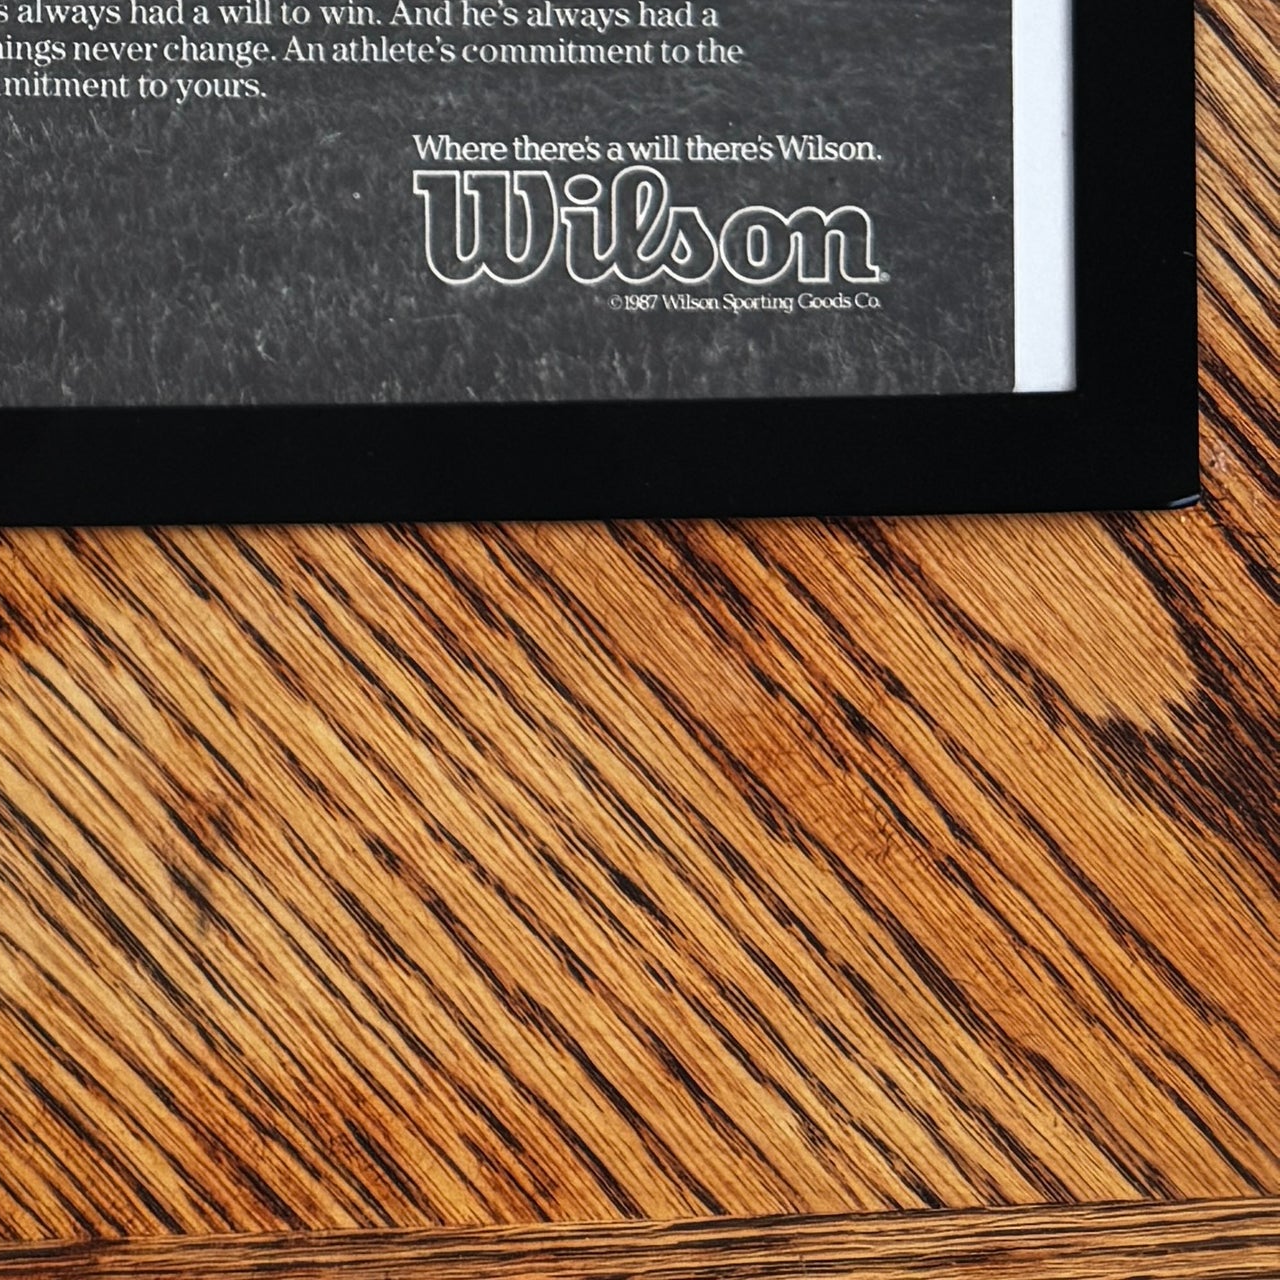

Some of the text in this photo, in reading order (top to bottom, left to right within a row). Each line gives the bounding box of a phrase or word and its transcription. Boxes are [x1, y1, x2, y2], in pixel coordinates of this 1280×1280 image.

[193, 6, 210, 24] a
[281, 2, 310, 24] to
[320, 0, 381, 25] win.
[390, 0, 452, 26] And
[461, 0, 519, 26] he's
[527, 1, 631, 33] always
[639, 1, 694, 27] had
[702, 8, 719, 27] a
[74, 42, 158, 61] never
[164, 35, 276, 68] change.
[283, 36, 326, 62] An
[332, 36, 456, 63] athlete's
[462, 38, 653, 63] commitment
[661, 41, 690, 63] to
[697, 38, 744, 64] the
[138, 75, 168, 98] to
[176, 79, 267, 104] yours.
[413, 135, 883, 161] Where there's a will there's Wilson.
[413, 166, 882, 284] Wilson
[662, 294, 720, 310] Wilson
[723, 294, 794, 314] Sporting
[798, 293, 852, 309] Goods
